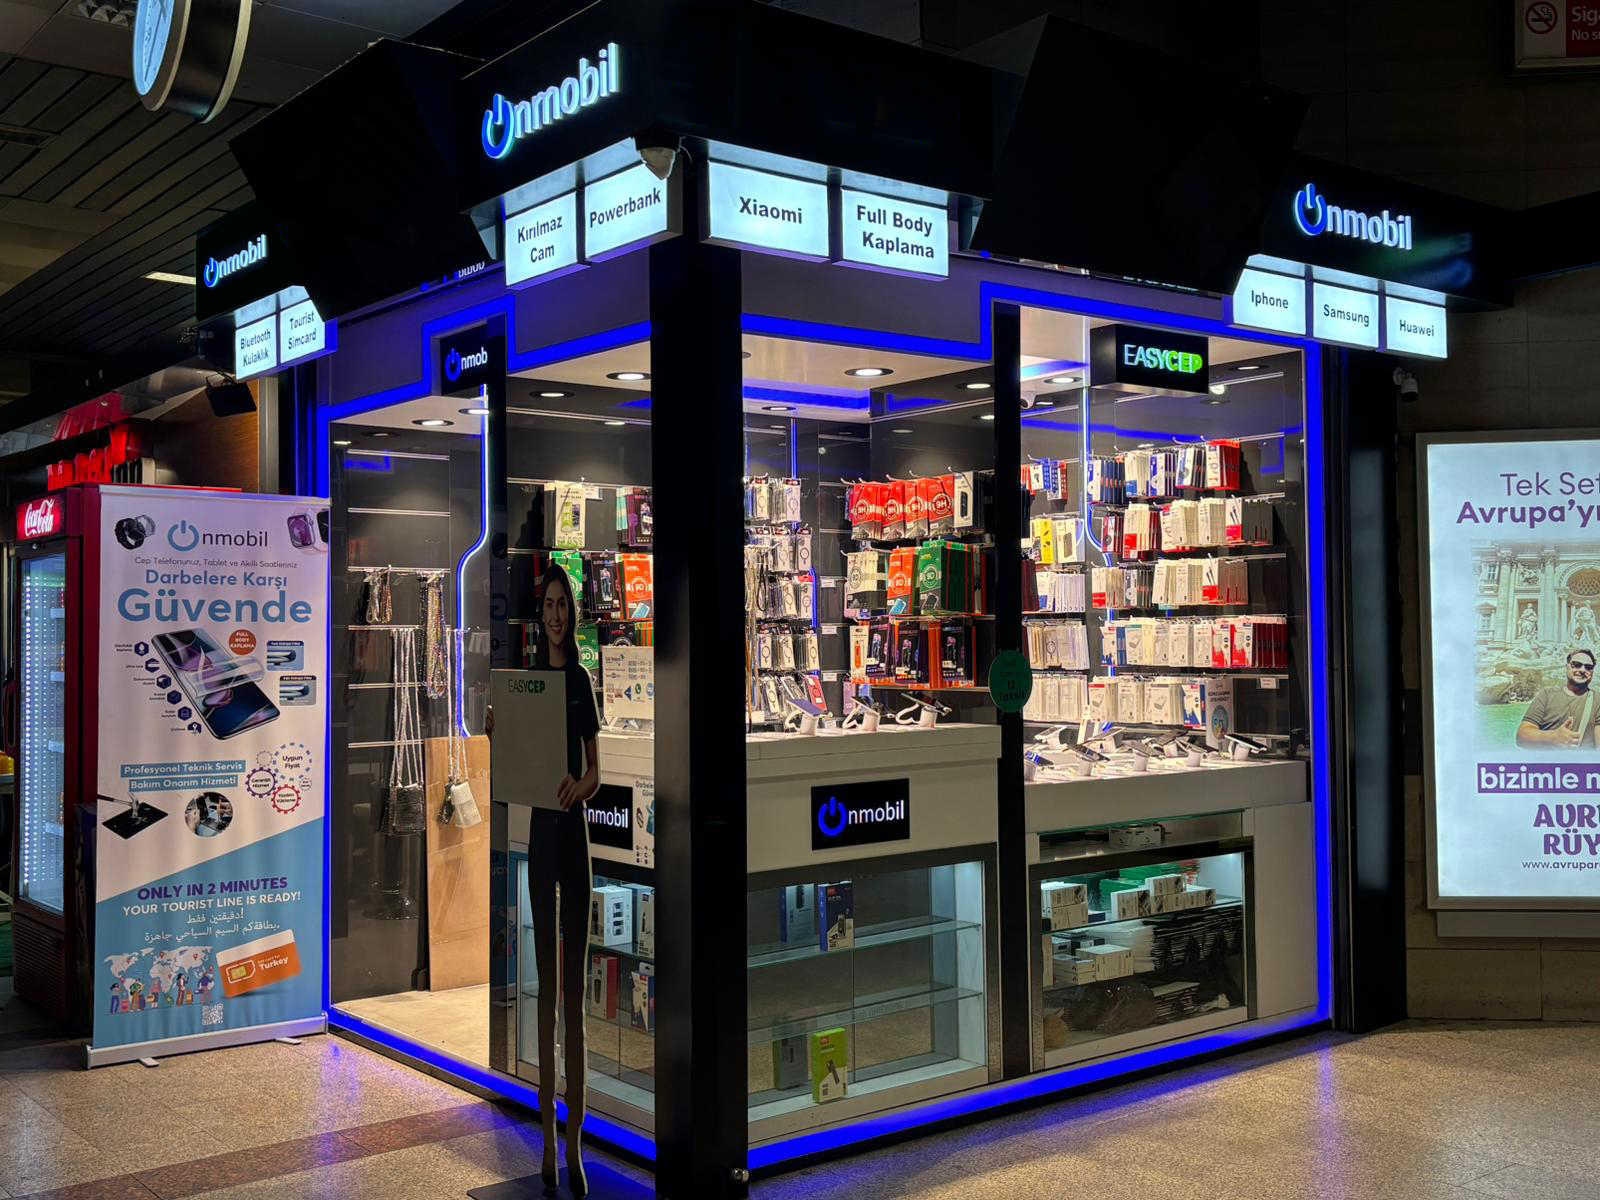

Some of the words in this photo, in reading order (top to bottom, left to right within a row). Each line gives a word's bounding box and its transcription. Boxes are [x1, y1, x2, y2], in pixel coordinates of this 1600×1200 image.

[1571, 28, 1590, 41] No
[589, 189, 661, 229] Powerbank
[738, 196, 803, 225] Xiaomi
[517, 215, 563, 244] Kırılmaz
[856, 204, 887, 226] Full
[892, 212, 933, 237] Body
[530, 244, 555, 263] Cam
[862, 231, 935, 259] Kaplama
[1250, 289, 1289, 309] Iphone
[289, 310, 315, 331] Tourist
[1323, 304, 1370, 328] Samsung
[1399, 319, 1435, 337] Huawei
[240, 329, 271, 350] Bluetooth
[288, 328, 317, 350] Simcard
[1123, 343, 1203, 374] EASYCEP
[1500, 471, 1552, 497] Tek
[203, 559, 228, 567] Tablet
[145, 569, 238, 586] Darbelere
[243, 571, 288, 590] Karşı
[117, 588, 313, 623] Güvende
[508, 678, 546, 695] EASYCEP
[124, 764, 181, 776] Profesyonel
[182, 763, 214, 773] Teknik
[215, 761, 243, 771] Servis
[282, 754, 303, 763] Uygun
[284, 762, 301, 770] Fiyat
[200, 776, 237, 787] Hizmeti
[1480, 765, 1579, 789] bizimle
[585, 807, 629, 830] nmobil
[1521, 861, 1600, 871] www.avrupar
[137, 884, 182, 901] ONLY
[187, 883, 204, 896] IN
[207, 882, 216, 895] 2
[220, 877, 288, 894] MINUTES
[122, 903, 158, 916] YOUR
[162, 899, 214, 913] TOURIST
[216, 897, 243, 908] LINE
[247, 895, 256, 905] IS
[259, 891, 301, 905] READY!
[258, 956, 290, 972] Turkey
